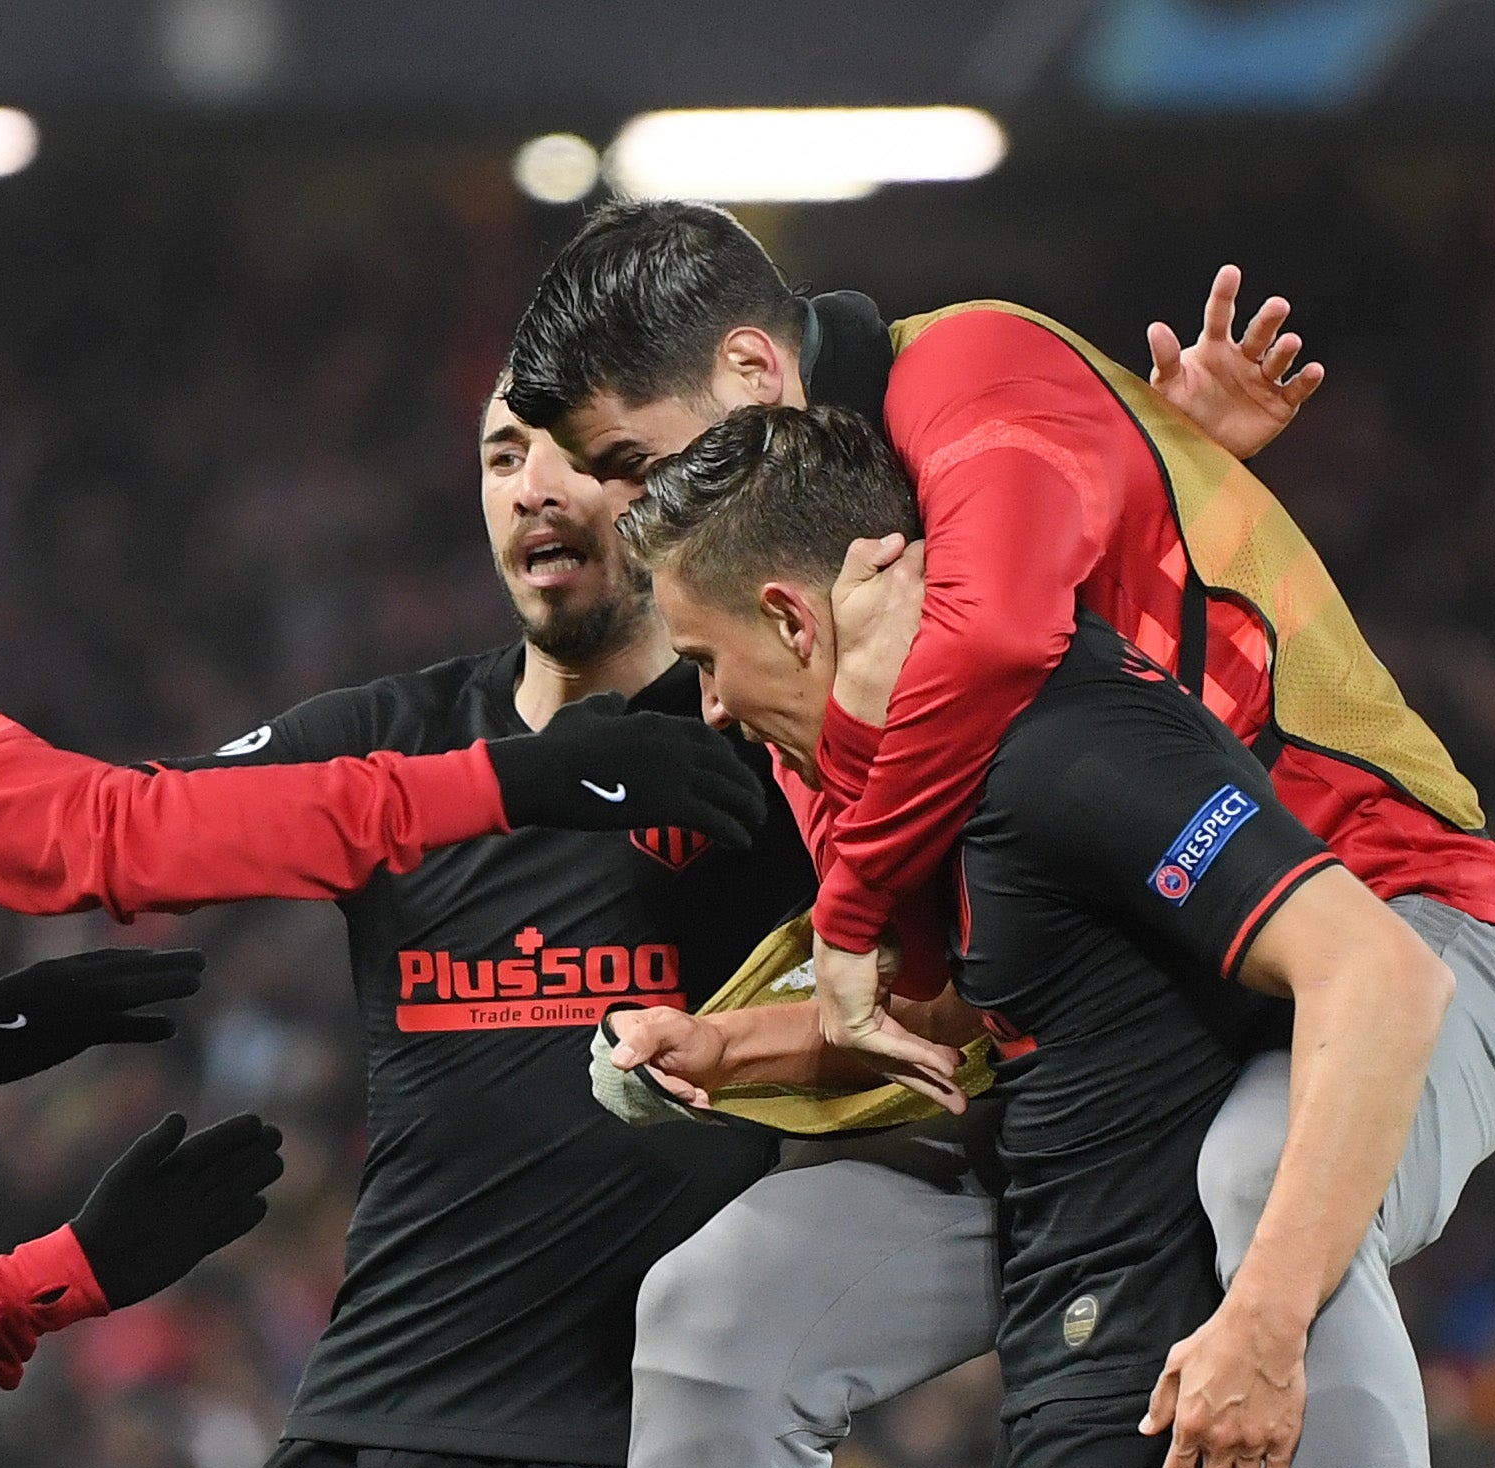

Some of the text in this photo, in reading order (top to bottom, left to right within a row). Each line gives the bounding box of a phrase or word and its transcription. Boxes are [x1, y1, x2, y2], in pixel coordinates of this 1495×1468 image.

[1177, 790, 1249, 871] RESPECT
[398, 943, 680, 999] Plus500
[469, 1004, 596, 1024] Trade Online
